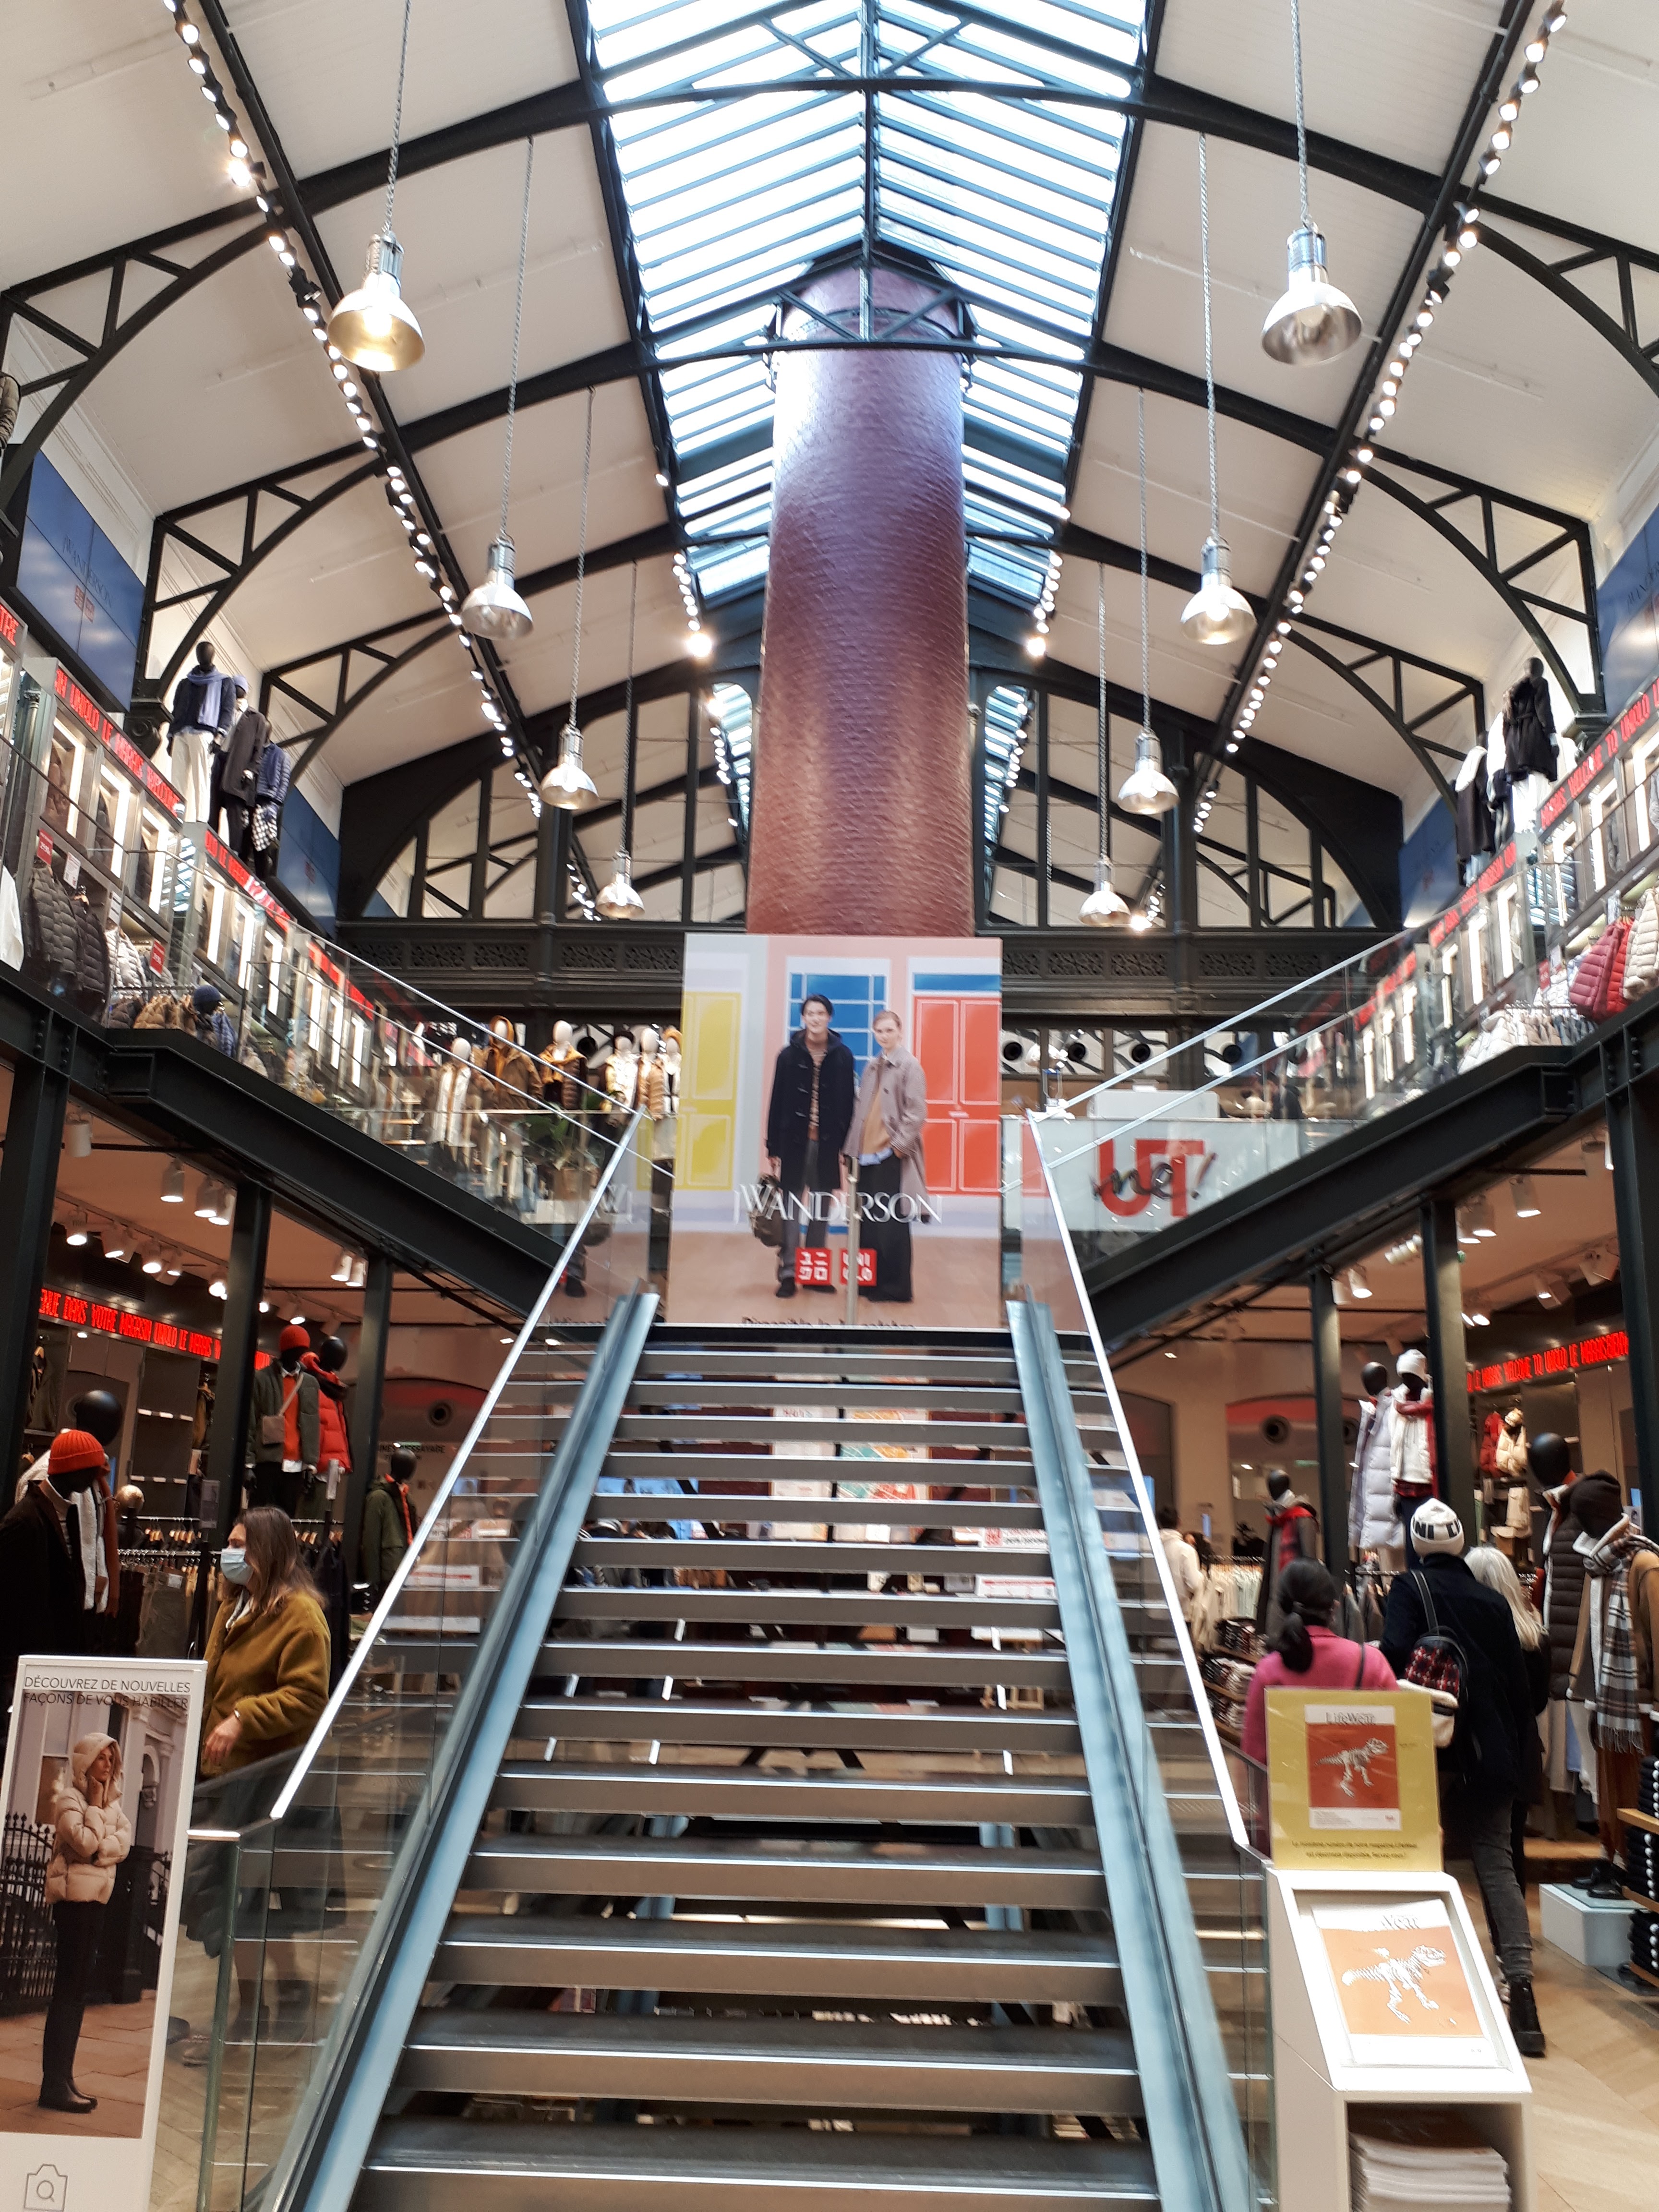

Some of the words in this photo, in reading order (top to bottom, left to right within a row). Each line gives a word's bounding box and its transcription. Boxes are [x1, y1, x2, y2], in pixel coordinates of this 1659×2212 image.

[24, 1675, 98, 1690] DÉCOUVREZ
[101, 1680, 117, 1690] DE
[121, 1680, 191, 1693] NOUVELLES
[24, 1692, 74, 1707] FAÇONS
[77, 1694, 92, 1706] DE
[96, 1695, 129, 1707] VOUS
[132, 1696, 188, 1708] HABILLER
